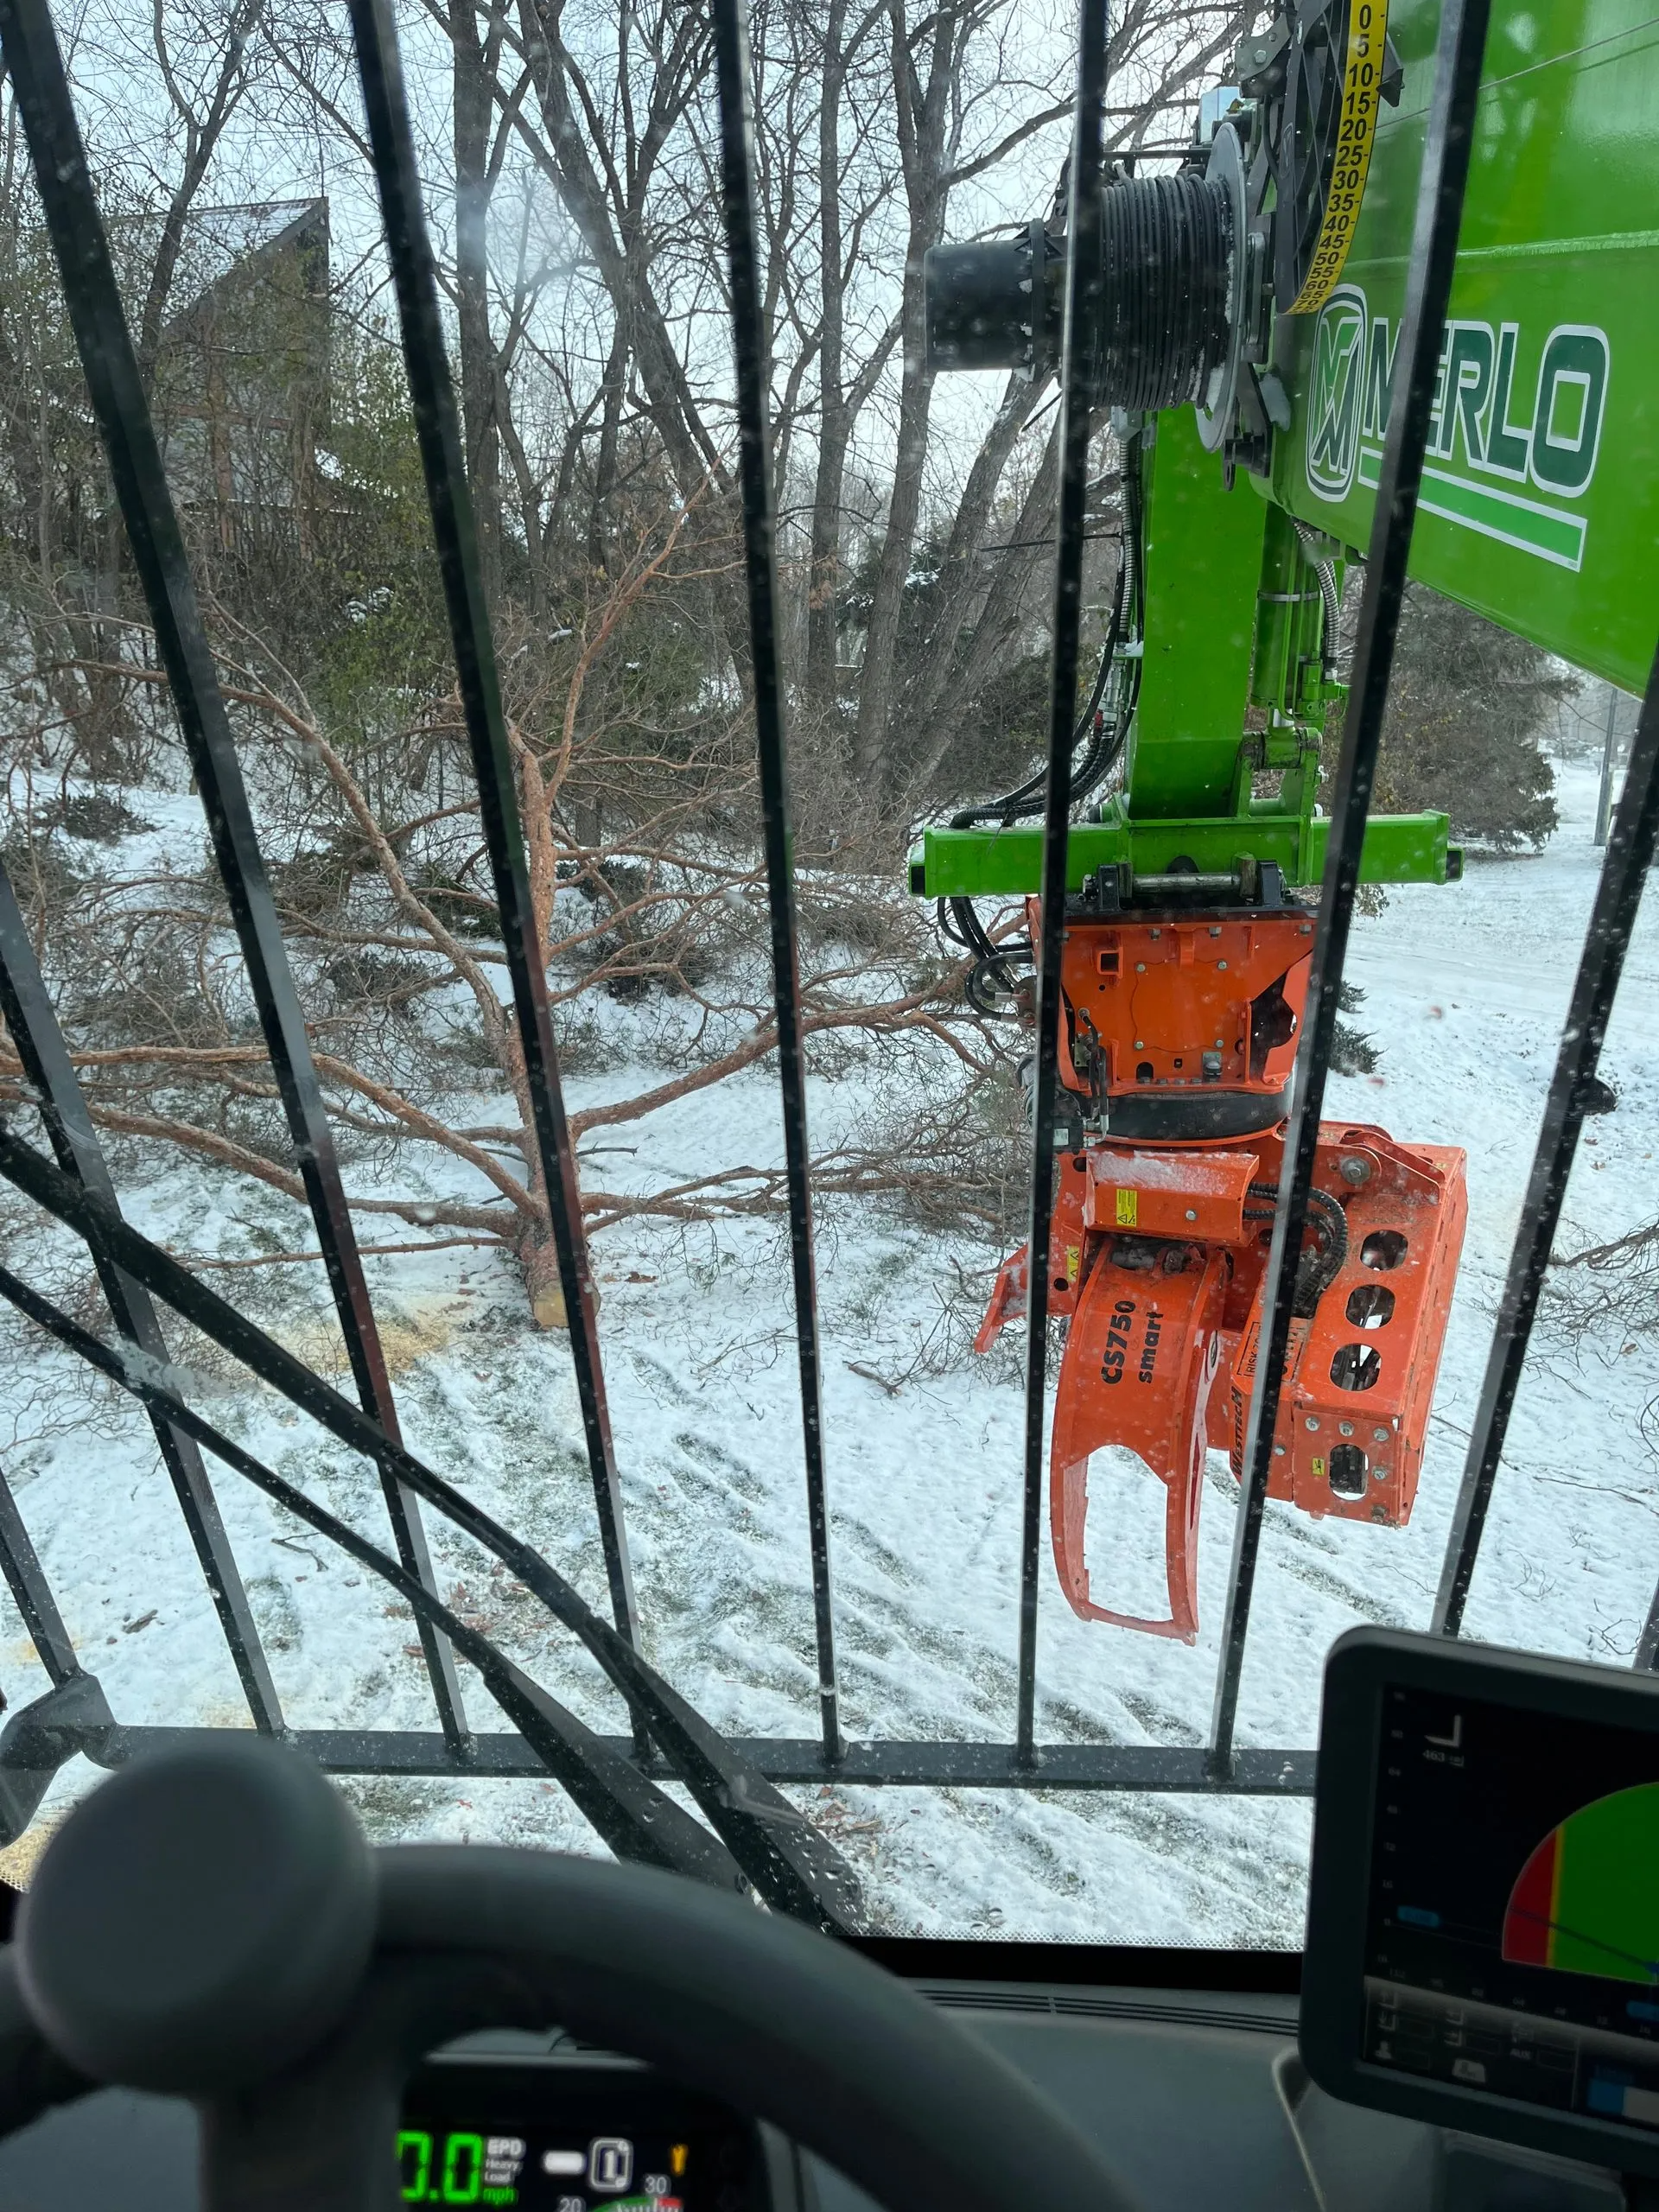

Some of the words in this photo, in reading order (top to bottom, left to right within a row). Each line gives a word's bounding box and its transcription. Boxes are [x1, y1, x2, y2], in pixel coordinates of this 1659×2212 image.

[1359, 4, 1372, 29] 0
[1357, 33, 1370, 58] 5
[1349, 62, 1374, 87] 10
[1346, 91, 1371, 115] 15
[1340, 118, 1367, 141] 20
[1336, 144, 1363, 167] 25
[1333, 169, 1359, 190] 30
[1328, 194, 1355, 213] 35
[1325, 214, 1350, 232] 40
[1319, 234, 1345, 249] 45
[1314, 251, 1339, 265] 50
[1310, 266, 1335, 279] 55
[1306, 279, 1329, 290] 60
[1101, 1300, 1136, 1384] CS750
[1138, 1312, 1164, 1384] smart
[486, 2137, 524, 2157] EPD
[485, 2158, 520, 2172] Heavy
[484, 2171, 512, 2183] Load
[645, 2176, 667, 2195] 30
[482, 2186, 517, 2205] mph
[559, 2197, 582, 2212] 20
